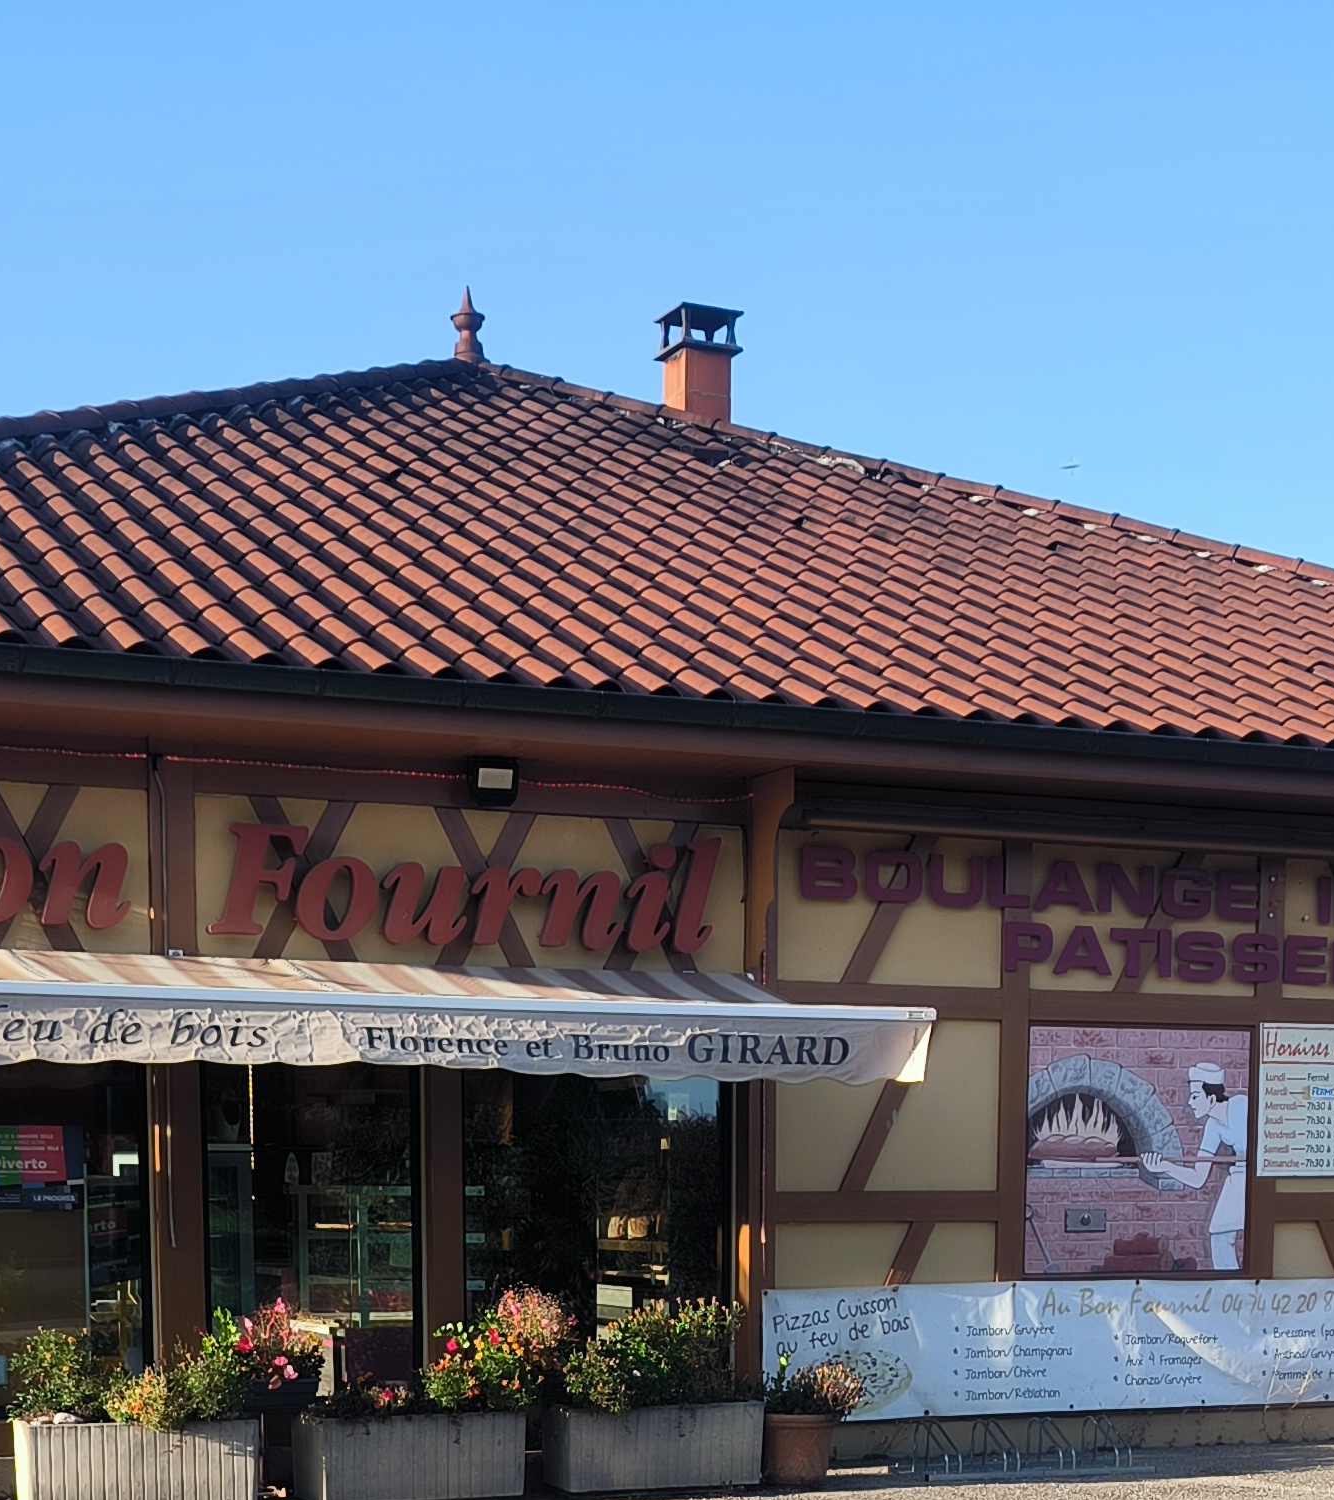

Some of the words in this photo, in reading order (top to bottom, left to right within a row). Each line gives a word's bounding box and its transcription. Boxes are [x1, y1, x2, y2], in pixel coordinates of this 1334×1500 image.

[205, 822, 722, 954] Fournil
[88, 1007, 142, 1046] de
[171, 1010, 268, 1049] bois
[366, 1025, 509, 1058] Florence
[524, 1031, 554, 1058] et
[572, 1033, 670, 1063] Bruno
[687, 1033, 850, 1066] GIRARD
[1266, 1031, 1329, 1058] Horaires
[1306, 1101, 1325, 1111] 7h30
[1306, 1115, 1325, 1125] 7h30
[1305, 1144, 1324, 1153] 7h30
[1306, 1130, 1325, 1139] 7h30
[1305, 1158, 1324, 1168] 7h30
[772, 1309, 830, 1333] Pizzas
[836, 1297, 897, 1320] Cuisson
[1042, 1287, 1070, 1317] Au
[1079, 1287, 1120, 1317] Bon
[1130, 1286, 1212, 1316] Fournil
[1222, 1293, 1243, 1316] 04
[1295, 1291, 1318, 1314] 20
[776, 1340, 798, 1356] au
[809, 1331, 838, 1349] feu
[849, 1322, 871, 1341] de
[879, 1313, 910, 1335] bois
